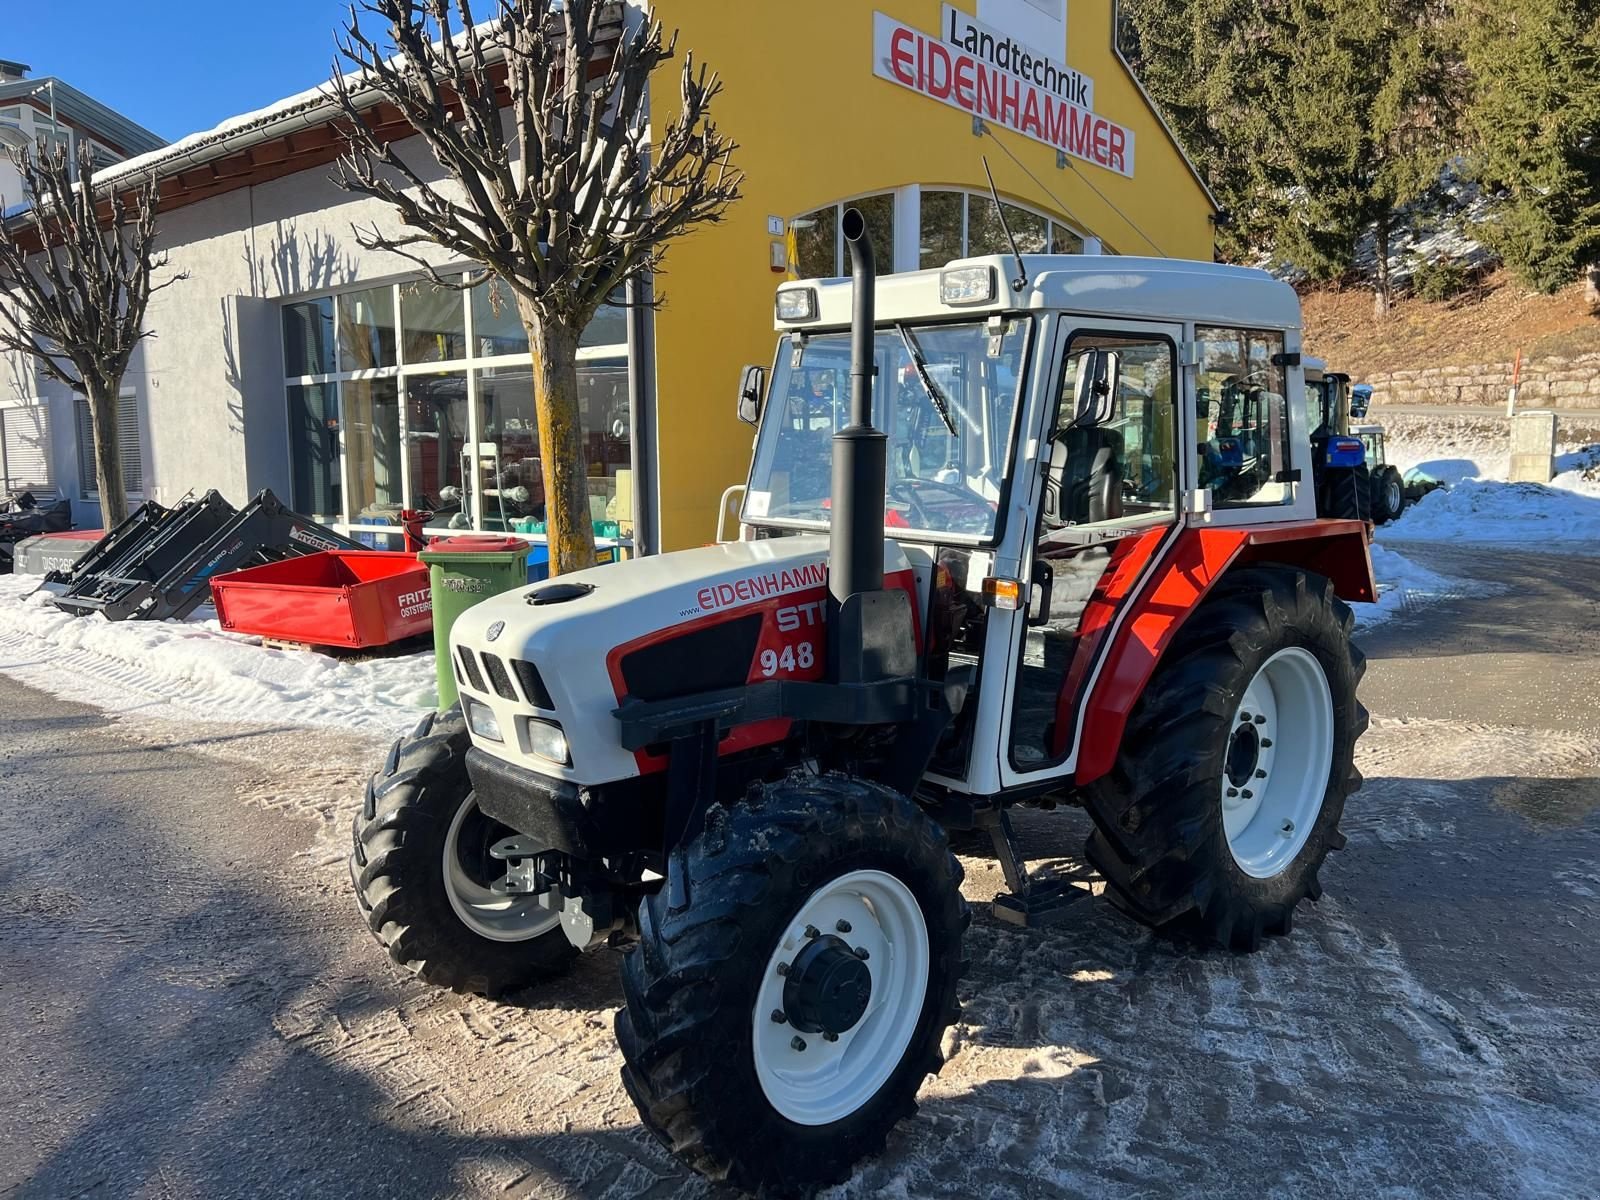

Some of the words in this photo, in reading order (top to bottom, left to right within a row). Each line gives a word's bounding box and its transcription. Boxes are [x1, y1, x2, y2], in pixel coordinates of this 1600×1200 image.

[891, 27, 1126, 172] EIDENHAMMER
[950, 9, 1088, 107] Landtechnik
[760, 642, 814, 677] 948
